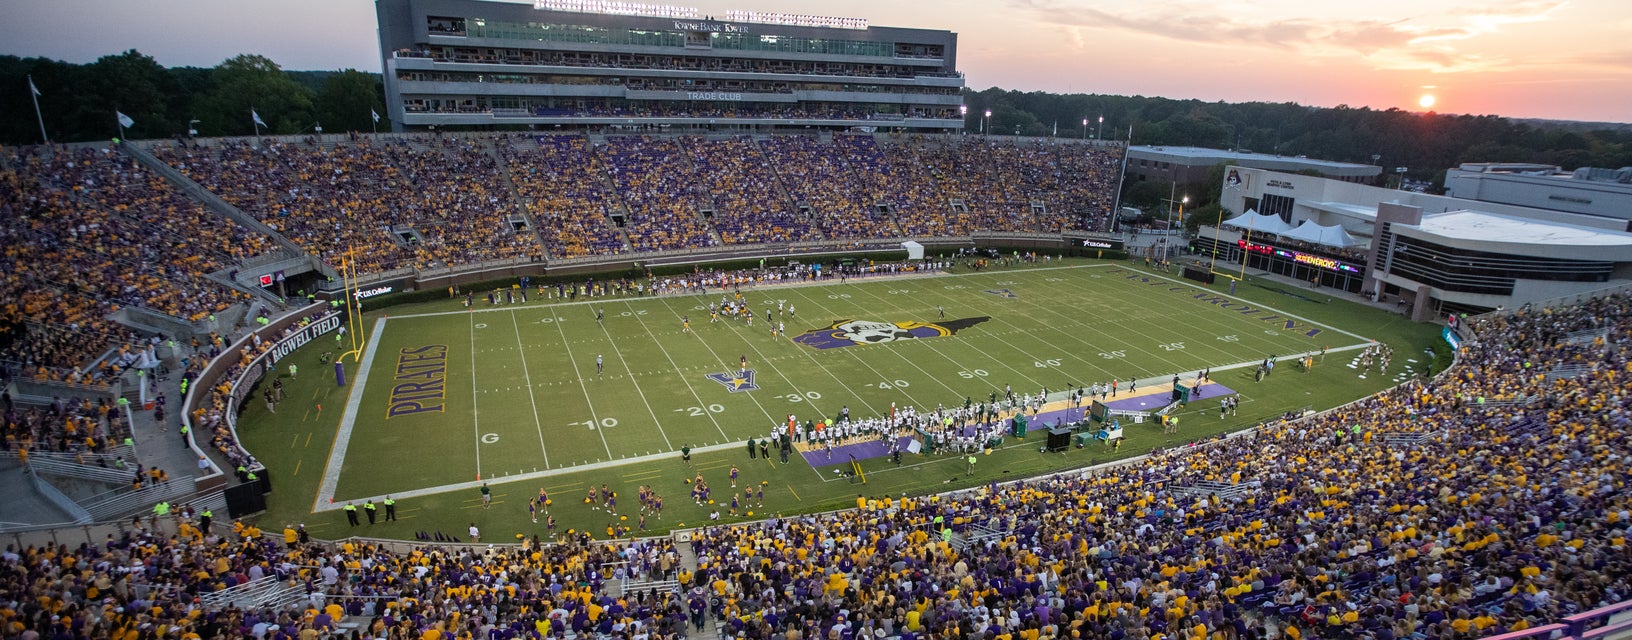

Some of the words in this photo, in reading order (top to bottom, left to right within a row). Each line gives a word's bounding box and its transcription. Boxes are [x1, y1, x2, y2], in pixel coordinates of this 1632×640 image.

[687, 92, 716, 100] TRADE
[272, 328, 312, 364] BAGWELL
[312, 316, 340, 339] FIELD
[1034, 359, 1061, 369] 40
[957, 369, 989, 379] 50
[386, 344, 448, 420] PIRATES
[879, 380, 909, 389] 40
[786, 391, 821, 402] 30
[686, 403, 725, 417] 20
[581, 417, 618, 430] 10
[481, 432, 499, 444] G
